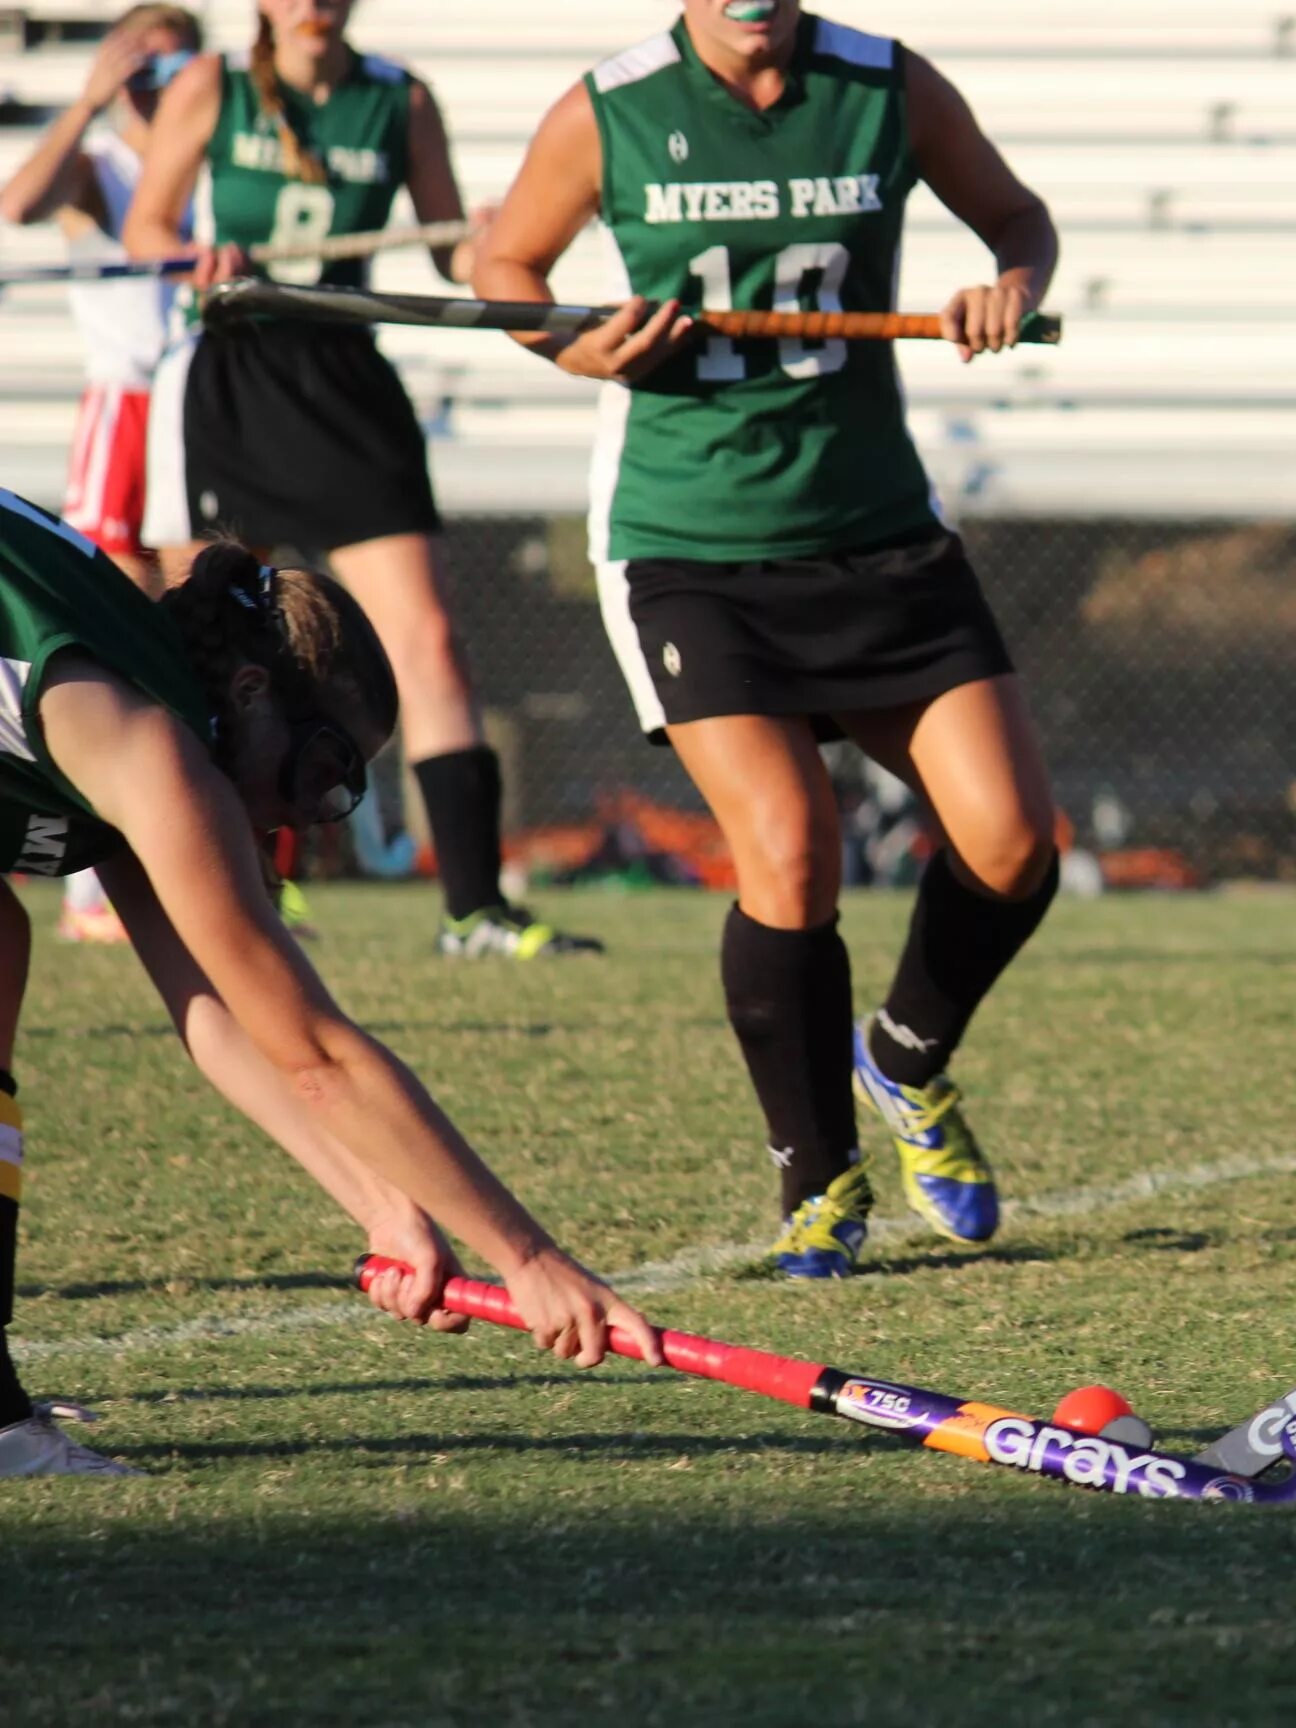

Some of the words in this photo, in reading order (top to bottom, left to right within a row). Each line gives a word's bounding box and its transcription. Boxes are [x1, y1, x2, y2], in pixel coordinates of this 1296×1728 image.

[644, 182, 780, 224] MYERS
[788, 173, 883, 218] PARK
[688, 242, 850, 382] 10
[870, 1389, 912, 1413] 750
